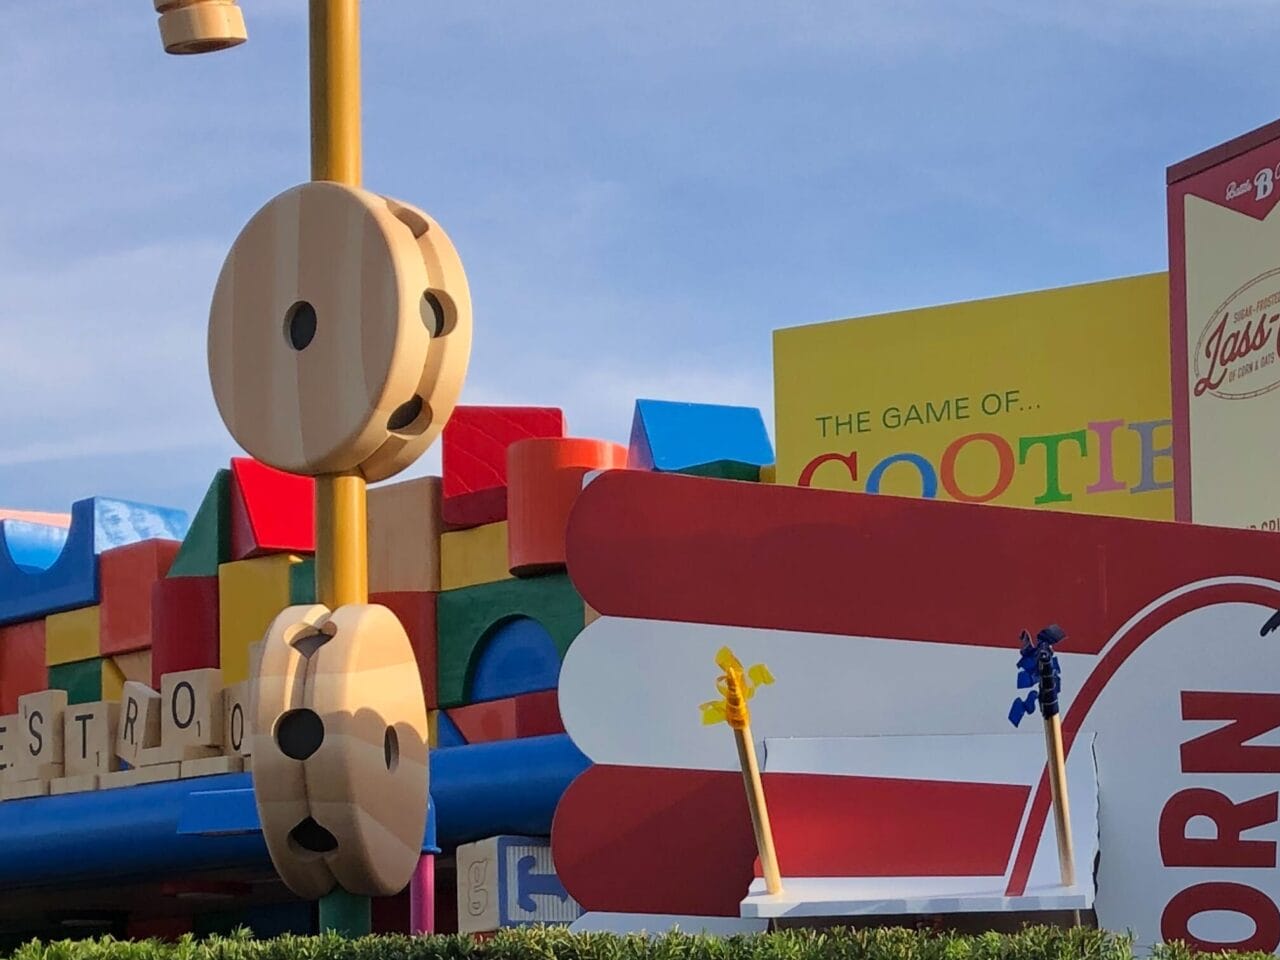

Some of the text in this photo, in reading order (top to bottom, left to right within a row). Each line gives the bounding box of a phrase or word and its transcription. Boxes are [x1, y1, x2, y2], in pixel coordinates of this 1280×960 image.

[1253, 167, 1274, 201] B
[1237, 364, 1253, 379] CORN
[1260, 352, 1275, 370] OATS
[816, 390, 1041, 438] THE GAME OF...
